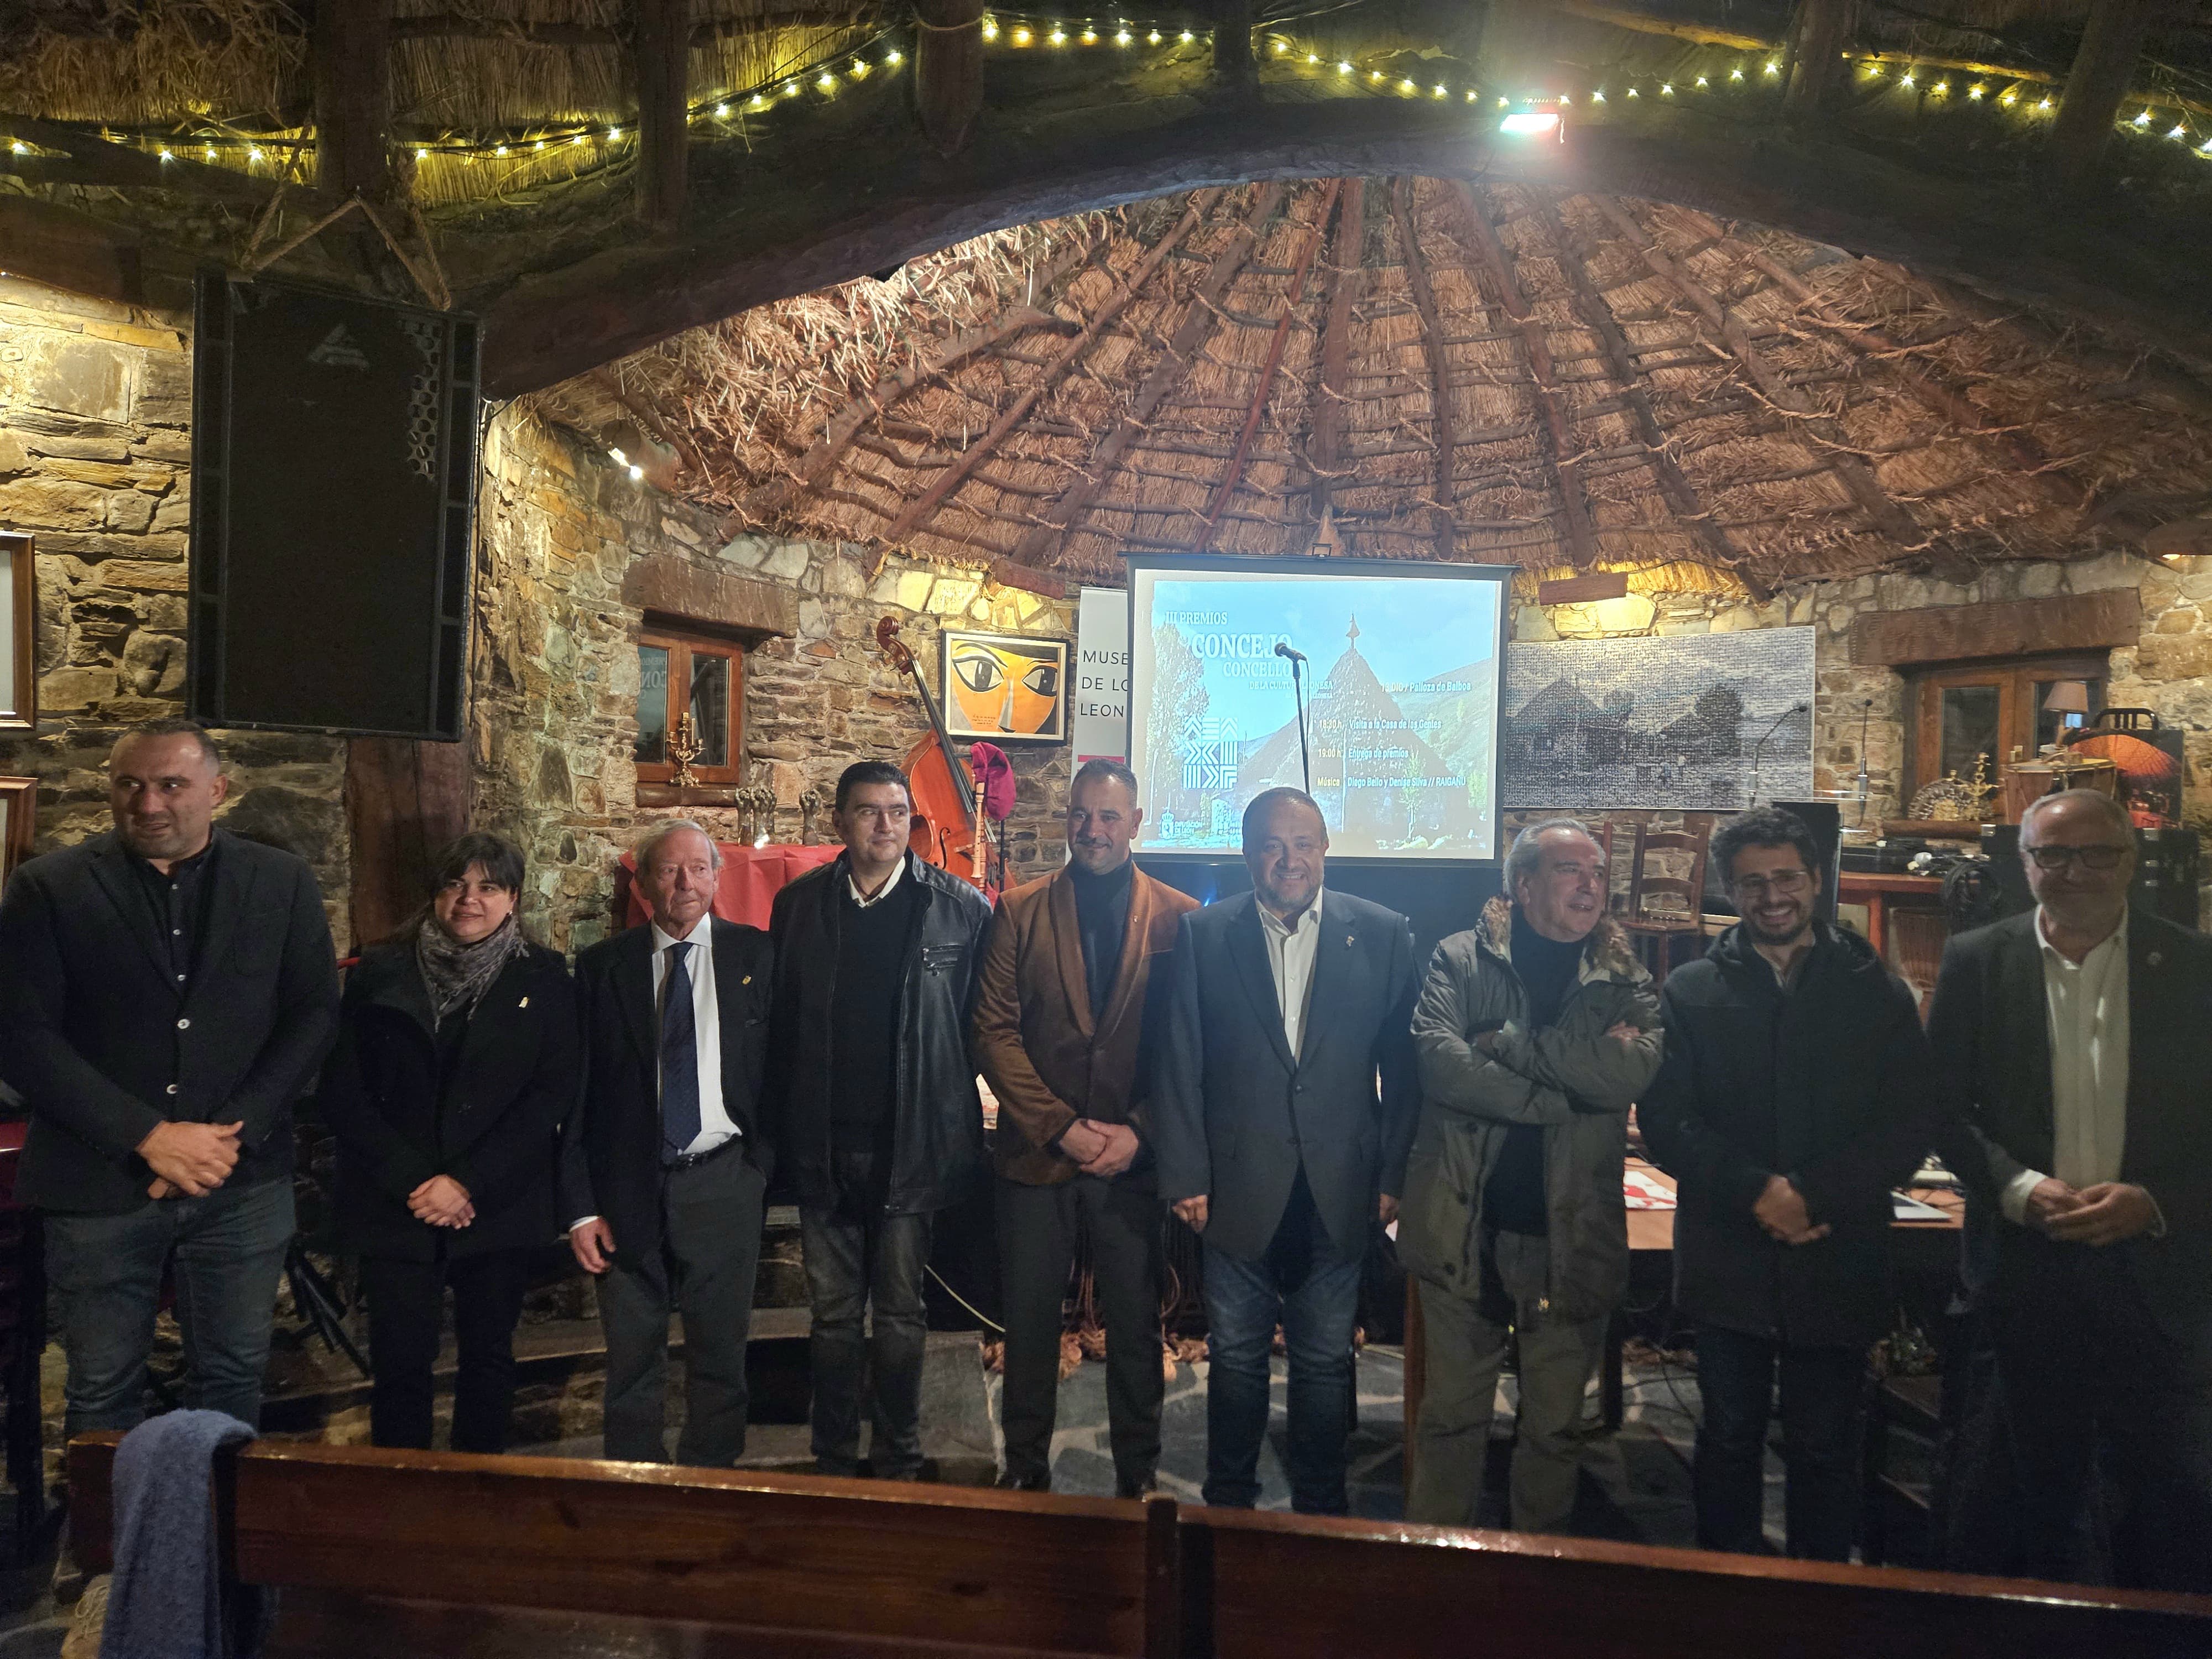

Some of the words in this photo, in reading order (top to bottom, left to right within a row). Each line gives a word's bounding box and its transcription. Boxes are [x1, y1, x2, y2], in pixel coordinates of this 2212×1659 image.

[1166, 611, 1178, 624] III
[1179, 611, 1228, 625] PREMIOS
[1223, 661, 1293, 678] CONCELLO
[1082, 677, 1104, 690] DE
[1250, 681, 1259, 690] DE
[1260, 681, 1269, 690] LA
[1436, 681, 1446, 692] de
[1447, 680, 1472, 691] Balboa
[1319, 719, 1337, 729] 18:30
[1349, 719, 1368, 729] Visita
[1374, 718, 1381, 729] la
[1381, 719, 1397, 729] Casa
[1399, 719, 1407, 729] de
[1408, 719, 1417, 729] los
[1418, 719, 1442, 729] Gentes
[1318, 748, 1335, 758] 19:00
[1337, 748, 1342, 758] h
[1348, 748, 1372, 760] Entrega
[1374, 748, 1382, 758] de
[1383, 749, 1408, 760] premios
[1317, 776, 1340, 787] Música
[1347, 776, 1366, 789] Diego
[1366, 777, 1383, 786] Bello
[1384, 778, 1388, 789] y
[1389, 776, 1411, 787] Denise
[1411, 776, 1427, 787] Silva
